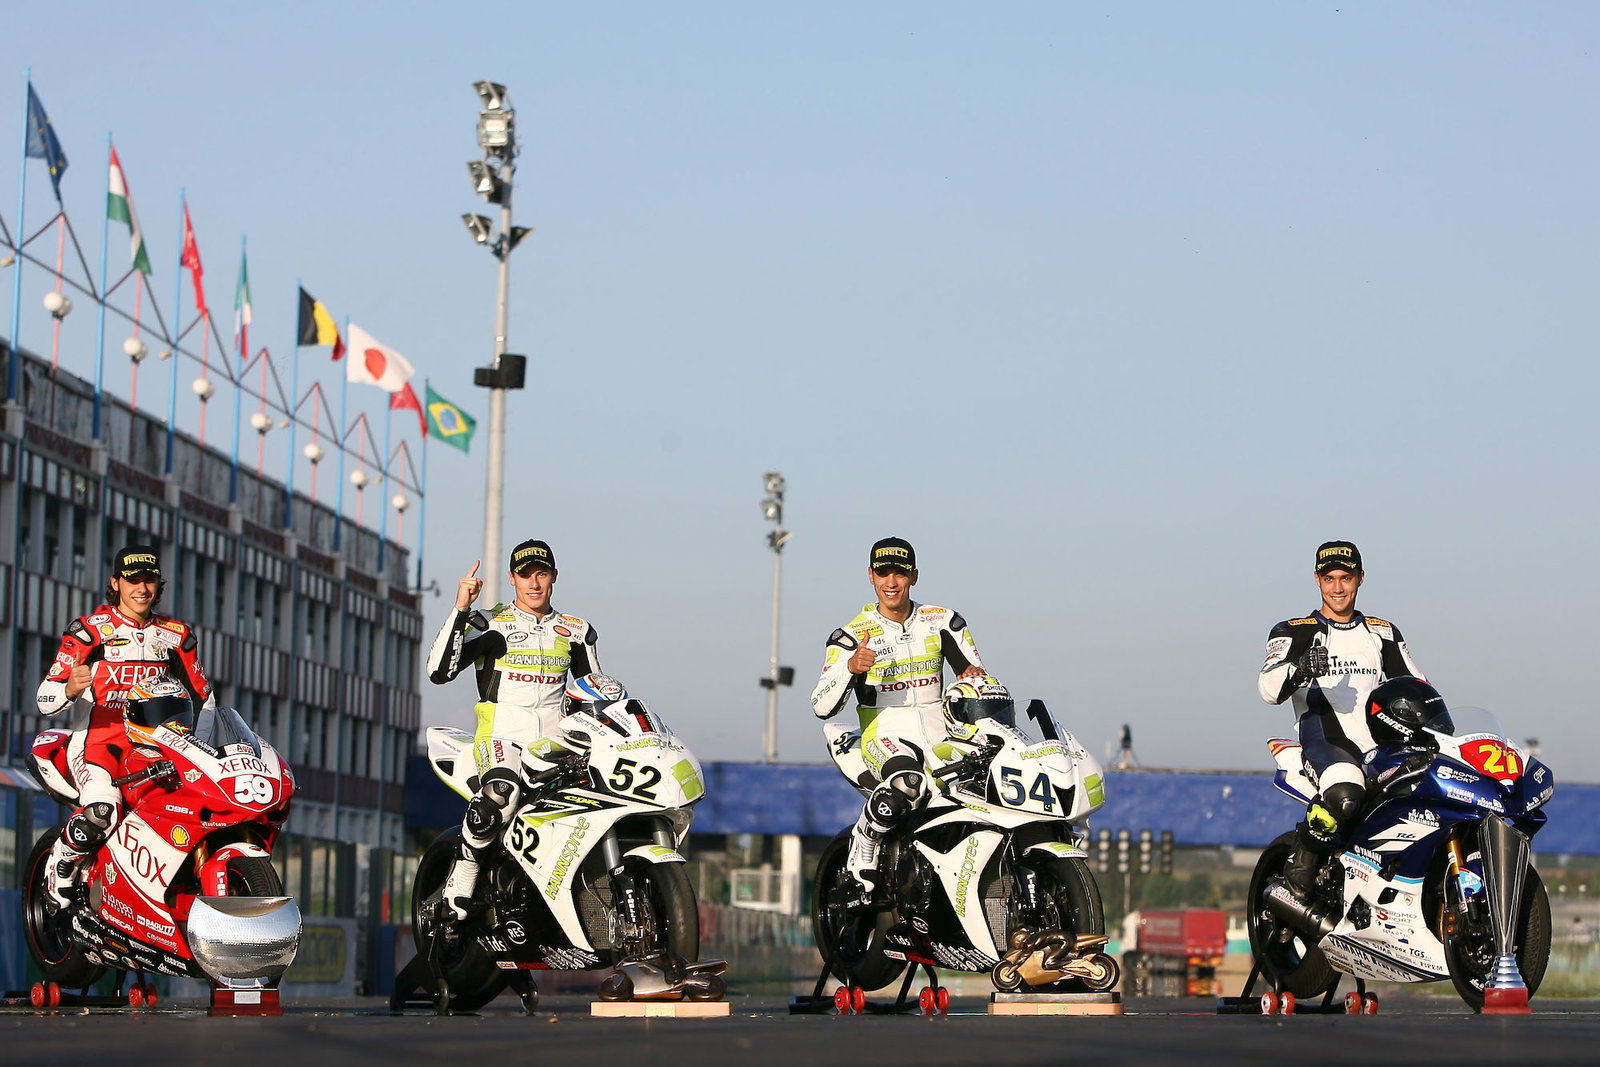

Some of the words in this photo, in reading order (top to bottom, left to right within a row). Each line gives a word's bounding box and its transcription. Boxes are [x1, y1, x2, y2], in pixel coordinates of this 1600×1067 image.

[875, 547, 908, 558] PIRELLI
[508, 672, 562, 684] HONDA
[881, 676, 940, 692] HONDA
[1377, 712, 1415, 737] DAINESE
[218, 757, 272, 775] XEROX
[234, 774, 274, 804] 59
[609, 758, 662, 801] 52
[1000, 766, 1056, 813] 54
[511, 816, 540, 866] 52
[545, 815, 591, 901] HANNspree
[955, 835, 979, 918] HANNspree
[507, 927, 525, 938] RES
[1328, 936, 1370, 962] YAMAHA
[1409, 947, 1425, 958] TGS
